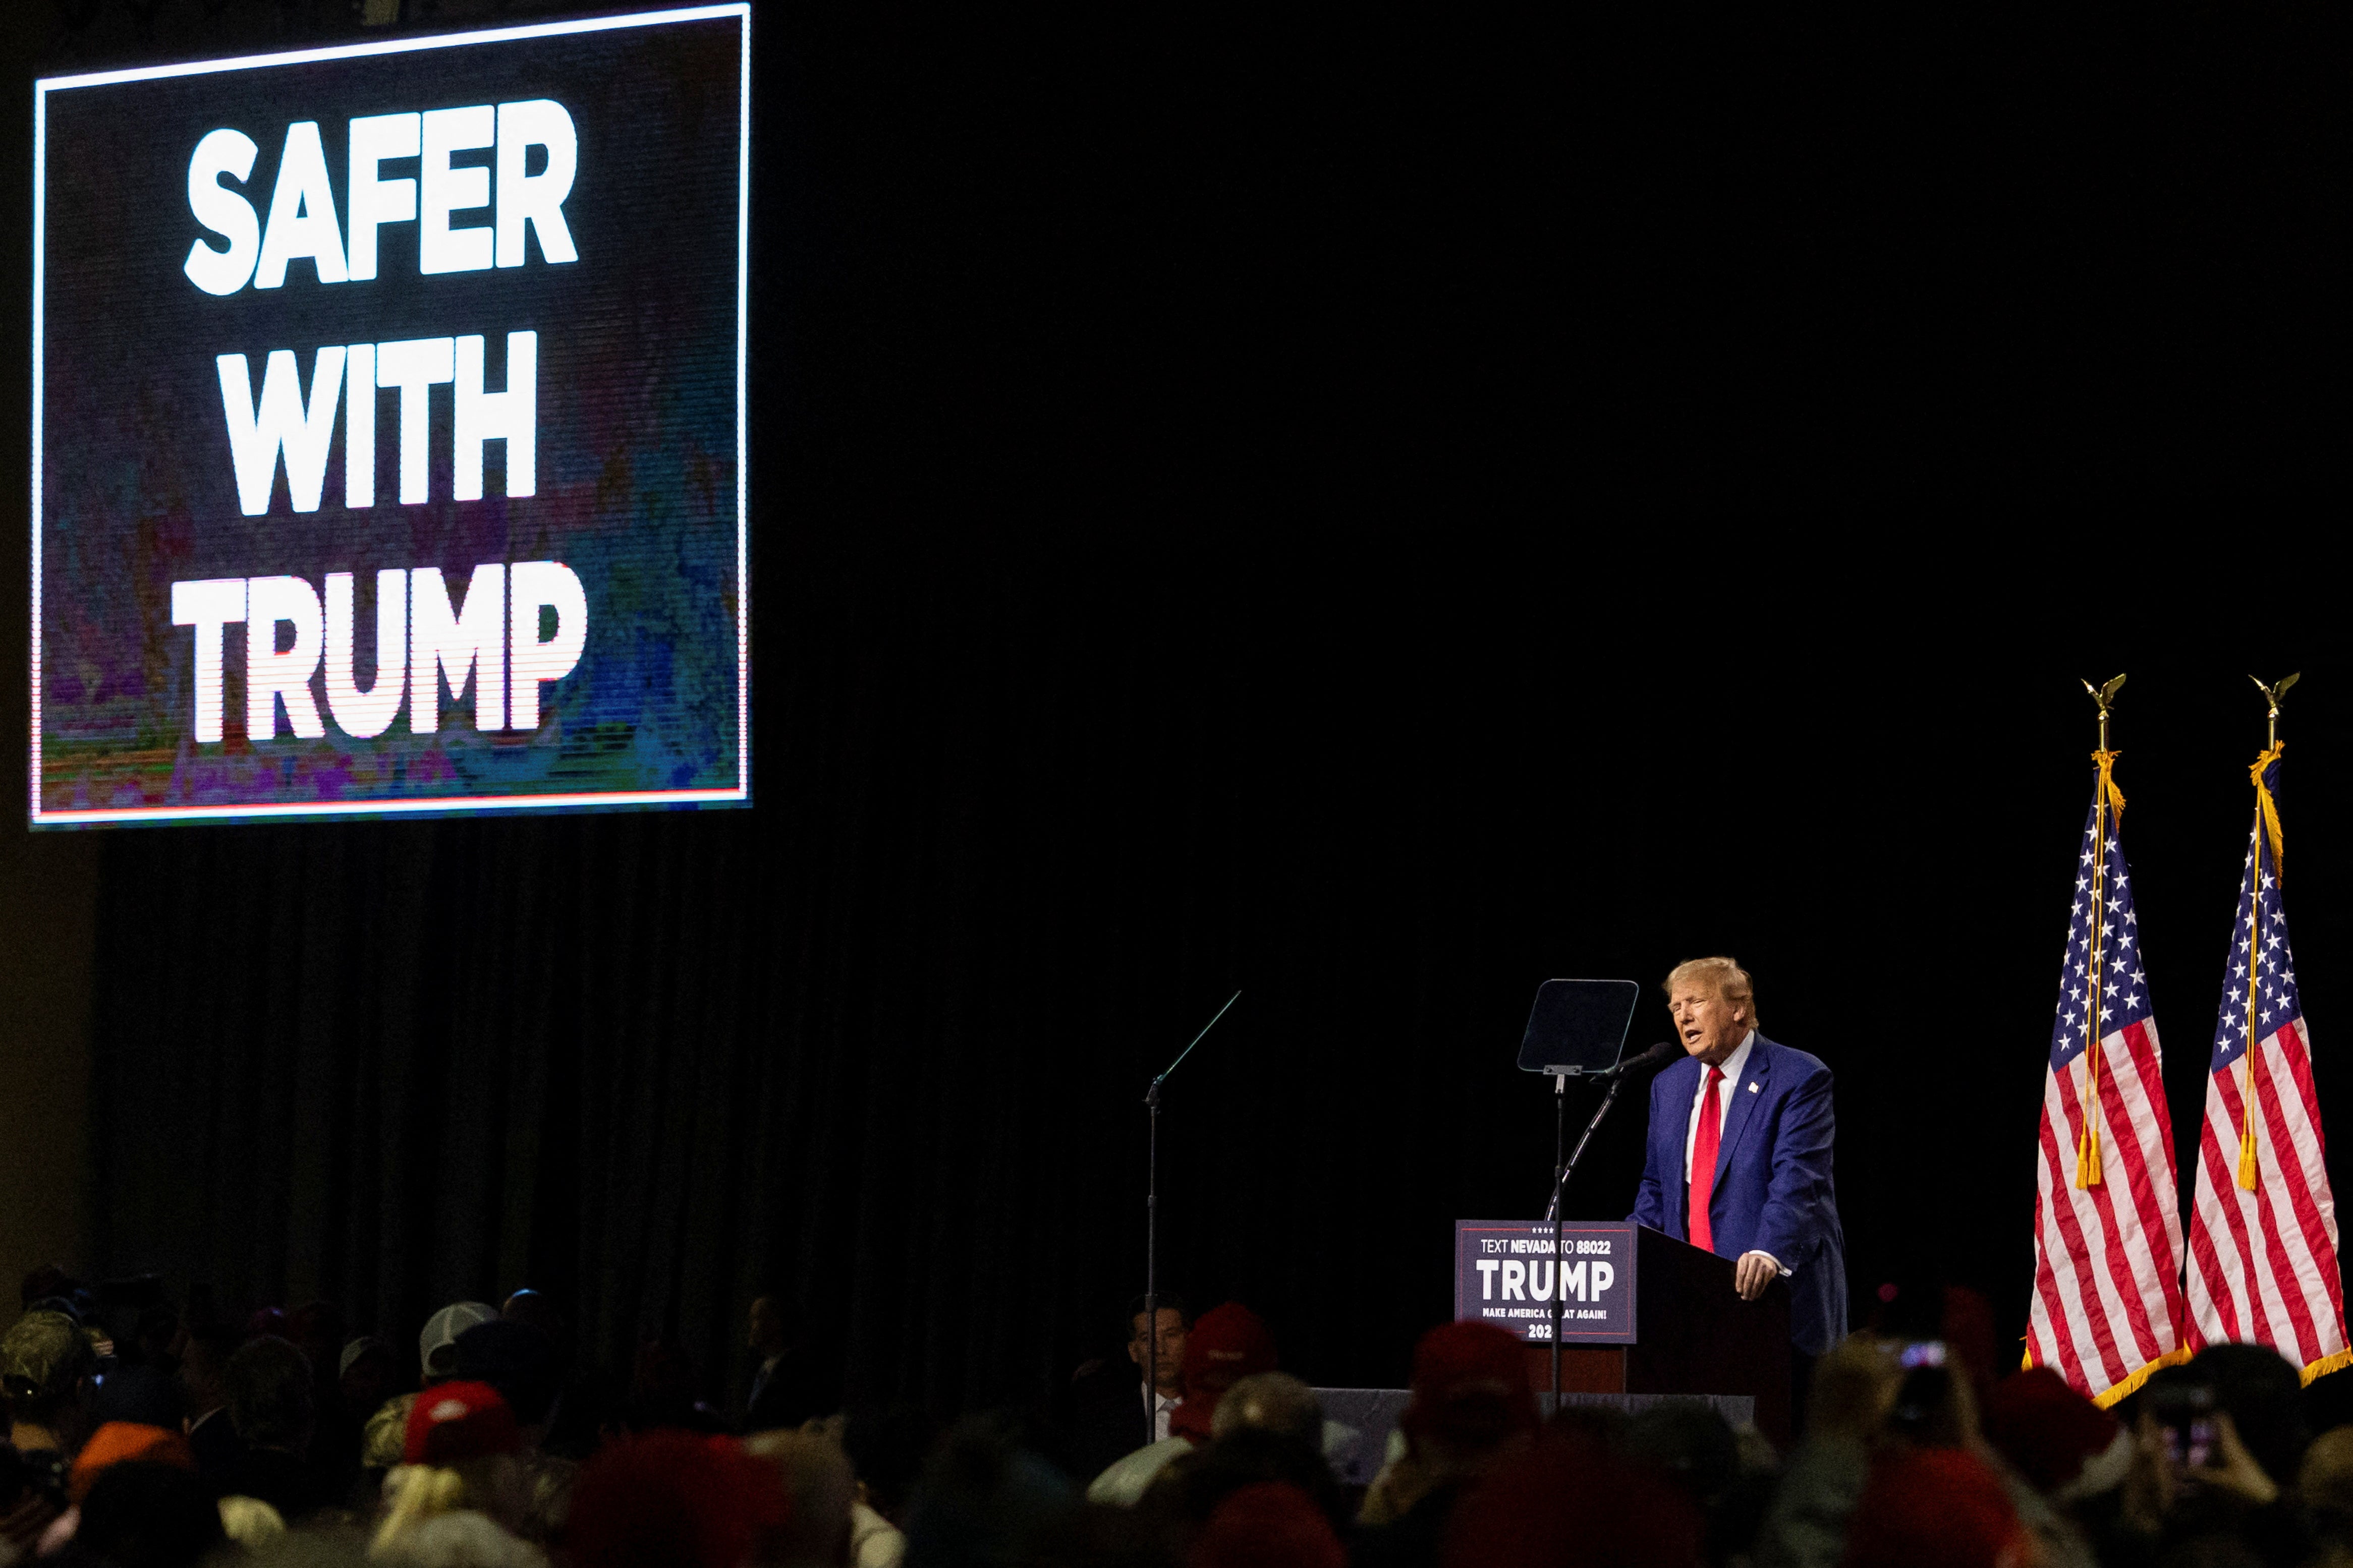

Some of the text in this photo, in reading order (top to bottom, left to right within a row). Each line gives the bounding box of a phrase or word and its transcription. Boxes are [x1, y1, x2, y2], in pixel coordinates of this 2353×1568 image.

[184, 99, 579, 296] SAFER
[216, 330, 538, 516] WITH
[172, 560, 588, 743] TRUMP
[1481, 1239, 1611, 1255] TEXT NEVADA TO 88022
[1476, 1259, 1614, 1302] TRUMP
[1482, 1308, 1607, 1320] MAKE AMERICA GAT AGAIN!
[1528, 1324, 1553, 1339] 202
